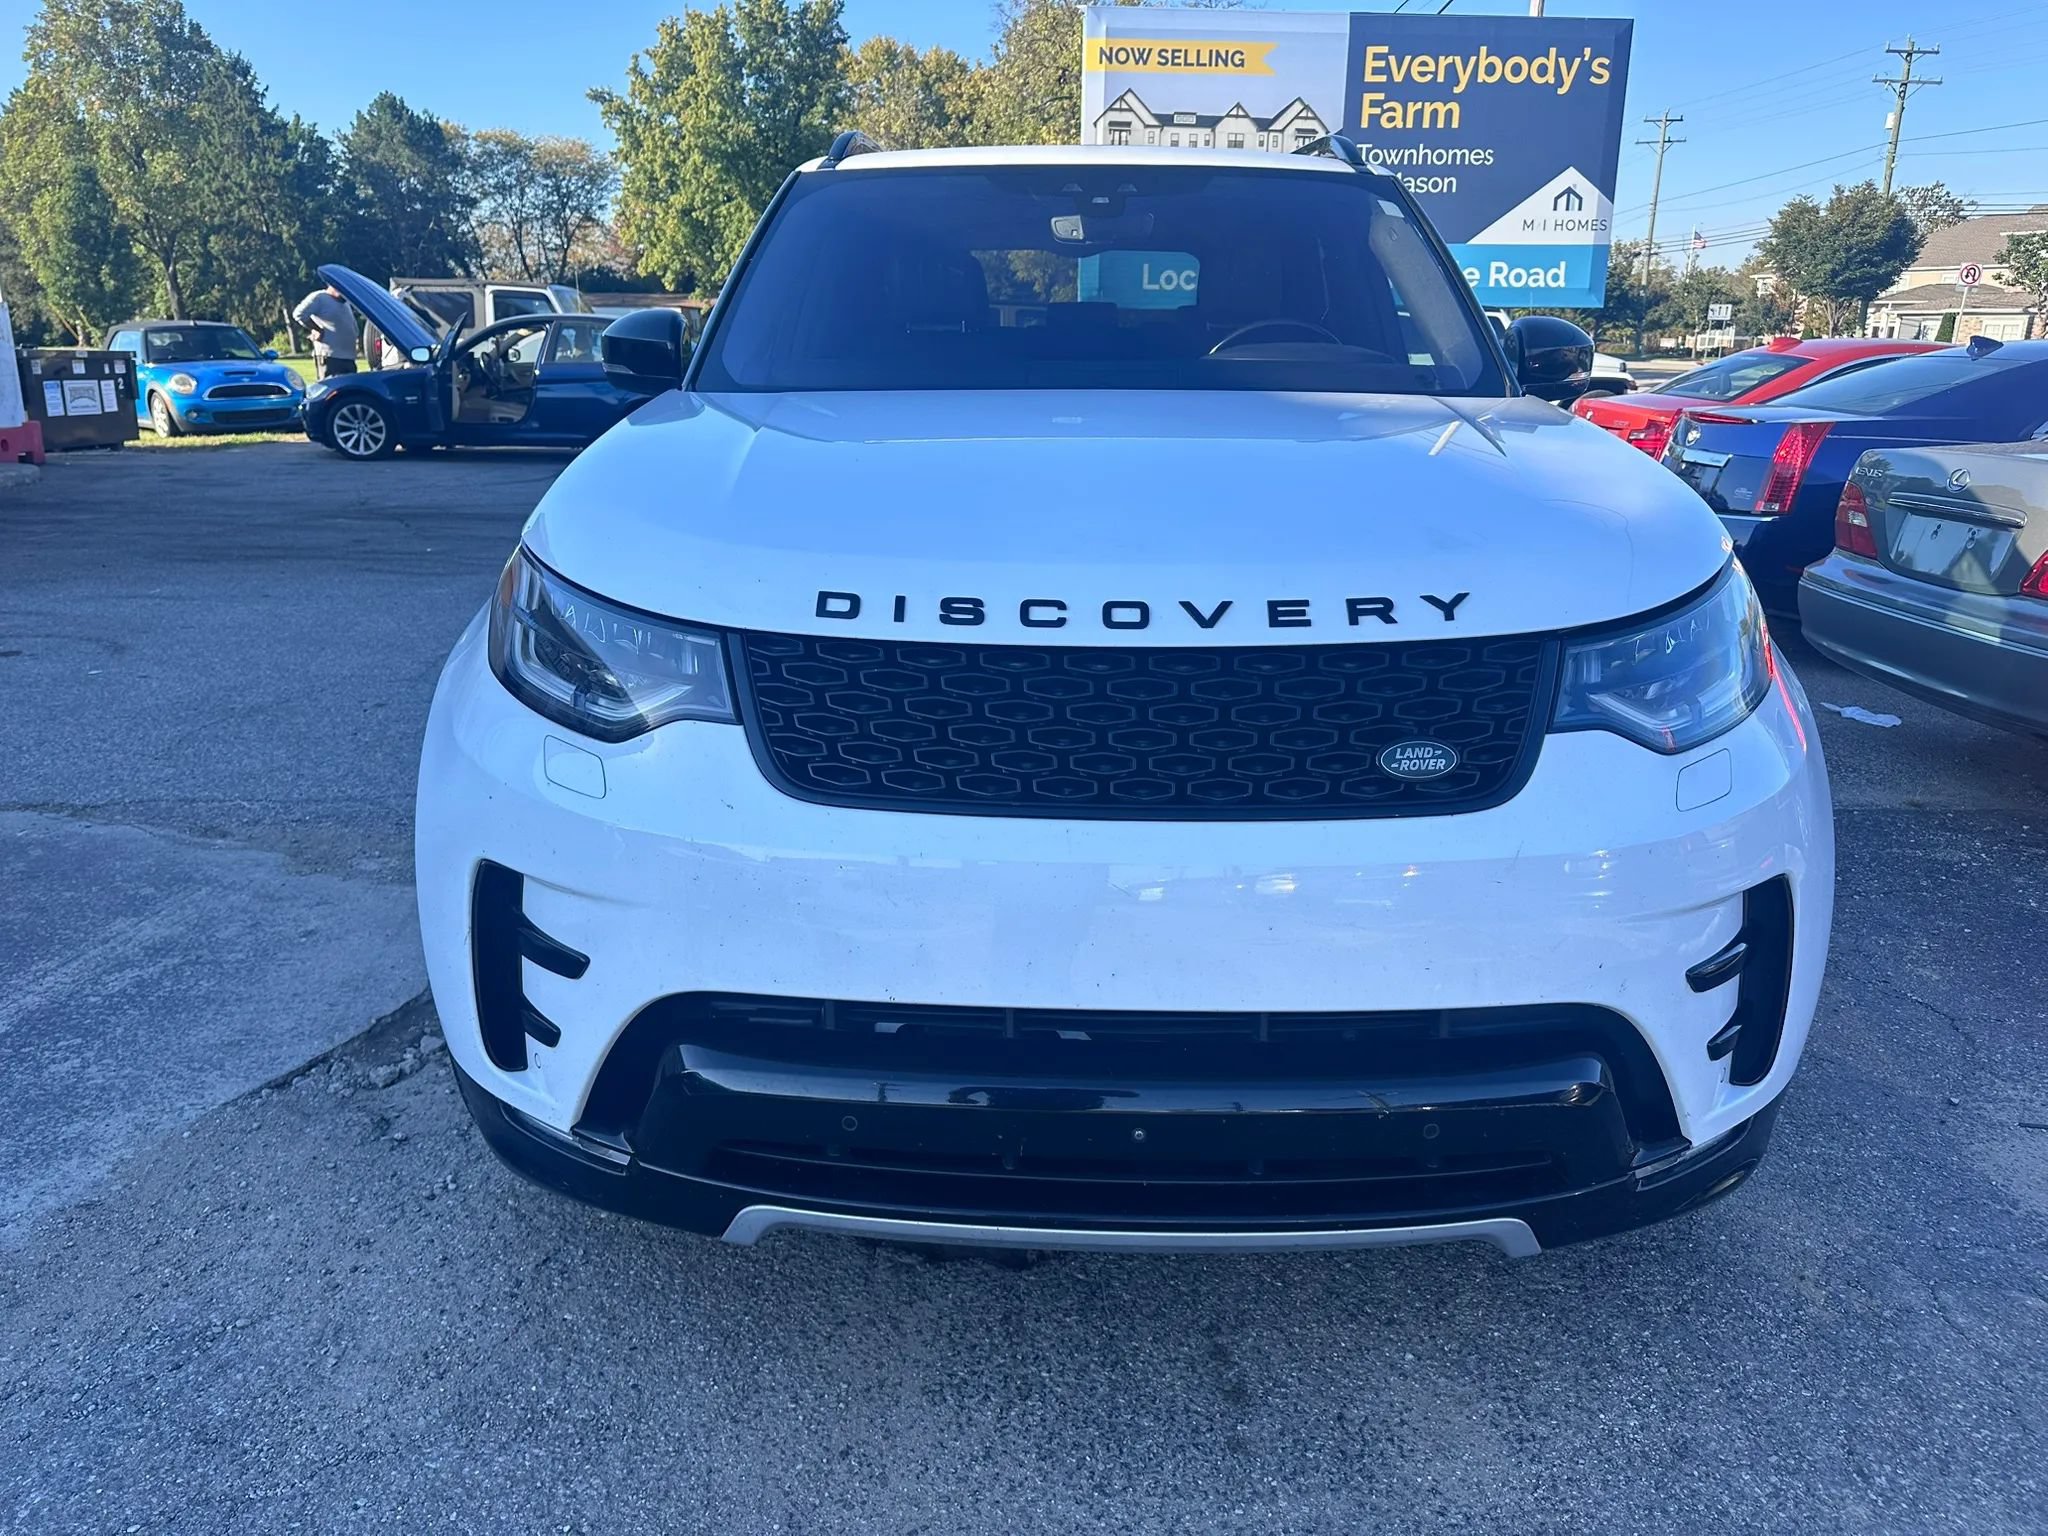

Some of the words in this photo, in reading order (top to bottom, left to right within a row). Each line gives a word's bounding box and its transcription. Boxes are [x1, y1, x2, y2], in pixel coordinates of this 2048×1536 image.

[1099, 47, 1153, 65] NOW
[1156, 48, 1245, 68] SELLING
[1363, 46, 1611, 95] Everybody’s
[1360, 92, 1461, 129] Farm
[1356, 143, 1494, 165] Townhomes
[1395, 171, 1457, 193] ason
[1554, 219, 1608, 231] HOMES
[1488, 261, 1567, 288] Road
[117, 377, 125, 389] 2
[815, 590, 1471, 630] DISCOVERY
[1395, 747, 1434, 759] LAND
[1399, 758, 1446, 771] ROVER
